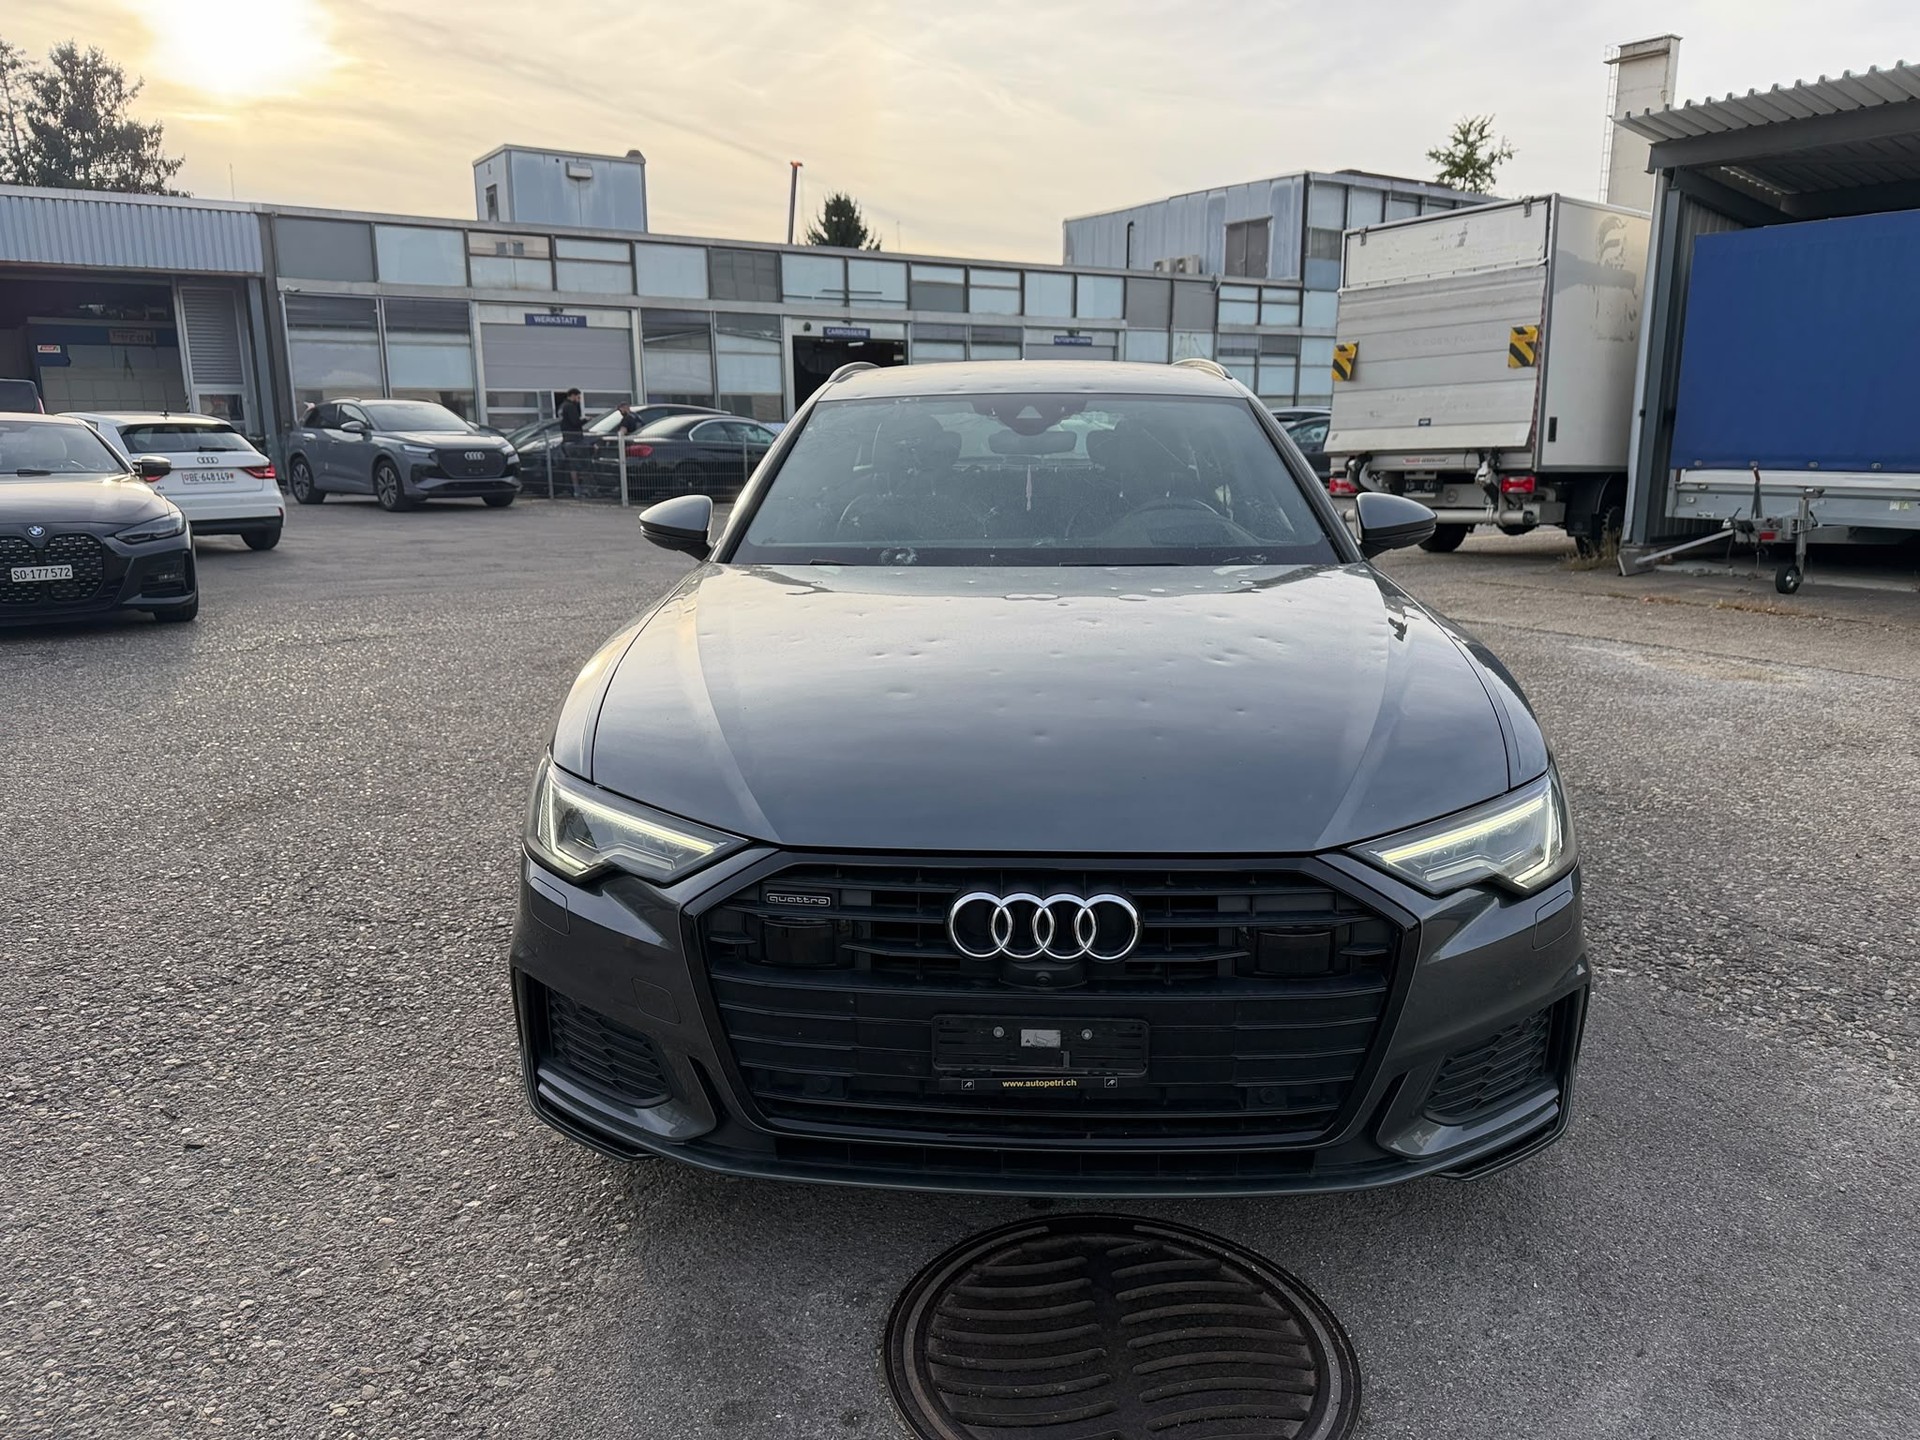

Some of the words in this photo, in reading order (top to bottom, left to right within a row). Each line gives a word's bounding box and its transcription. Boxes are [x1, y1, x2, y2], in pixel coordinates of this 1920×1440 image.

[533, 315, 578, 324] WERKSTATT
[769, 895, 827, 905] quattro
[1002, 1079, 1078, 1088] www.autopetri.ch
